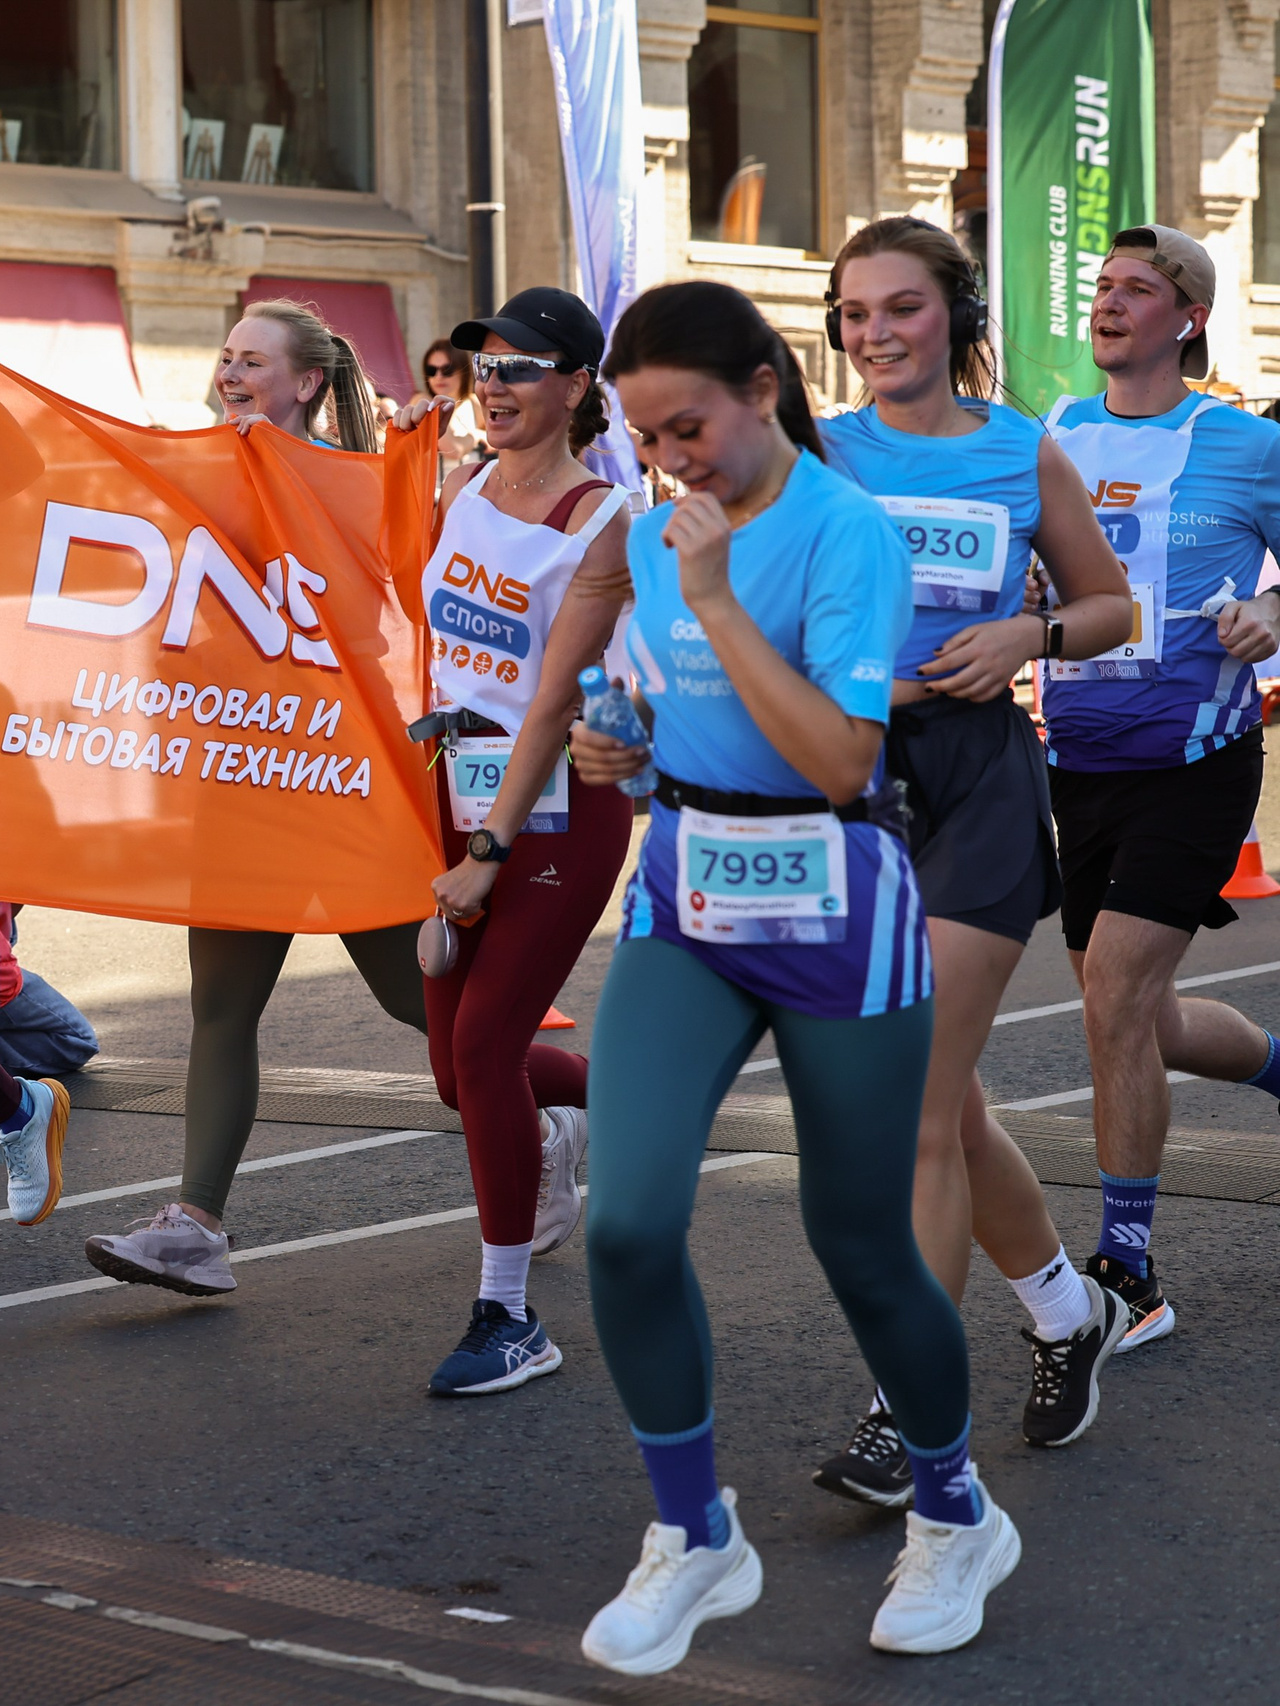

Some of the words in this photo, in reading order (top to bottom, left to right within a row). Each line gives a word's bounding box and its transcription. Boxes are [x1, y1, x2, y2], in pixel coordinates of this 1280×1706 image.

[1049, 185, 1067, 237] CLUB
[1049, 240, 1068, 338] RUNNING
[899, 525, 979, 560] 930
[26, 500, 341, 671] DNS
[441, 552, 531, 614] DNS
[441, 602, 514, 644] СПОРТ
[1098, 663, 1140, 678] 10km
[1124, 647, 1134, 657] D
[72, 668, 302, 735] ЦИФРОВАЯ
[306, 698, 342, 739] И
[1, 713, 191, 777] БЫТОВАЯ
[199, 740, 372, 799] ТЕХНИКА
[449, 749, 457, 758] D
[465, 763, 508, 789] 79
[700, 848, 808, 886] 7993
[1105, 1195, 1156, 1208] Marath
